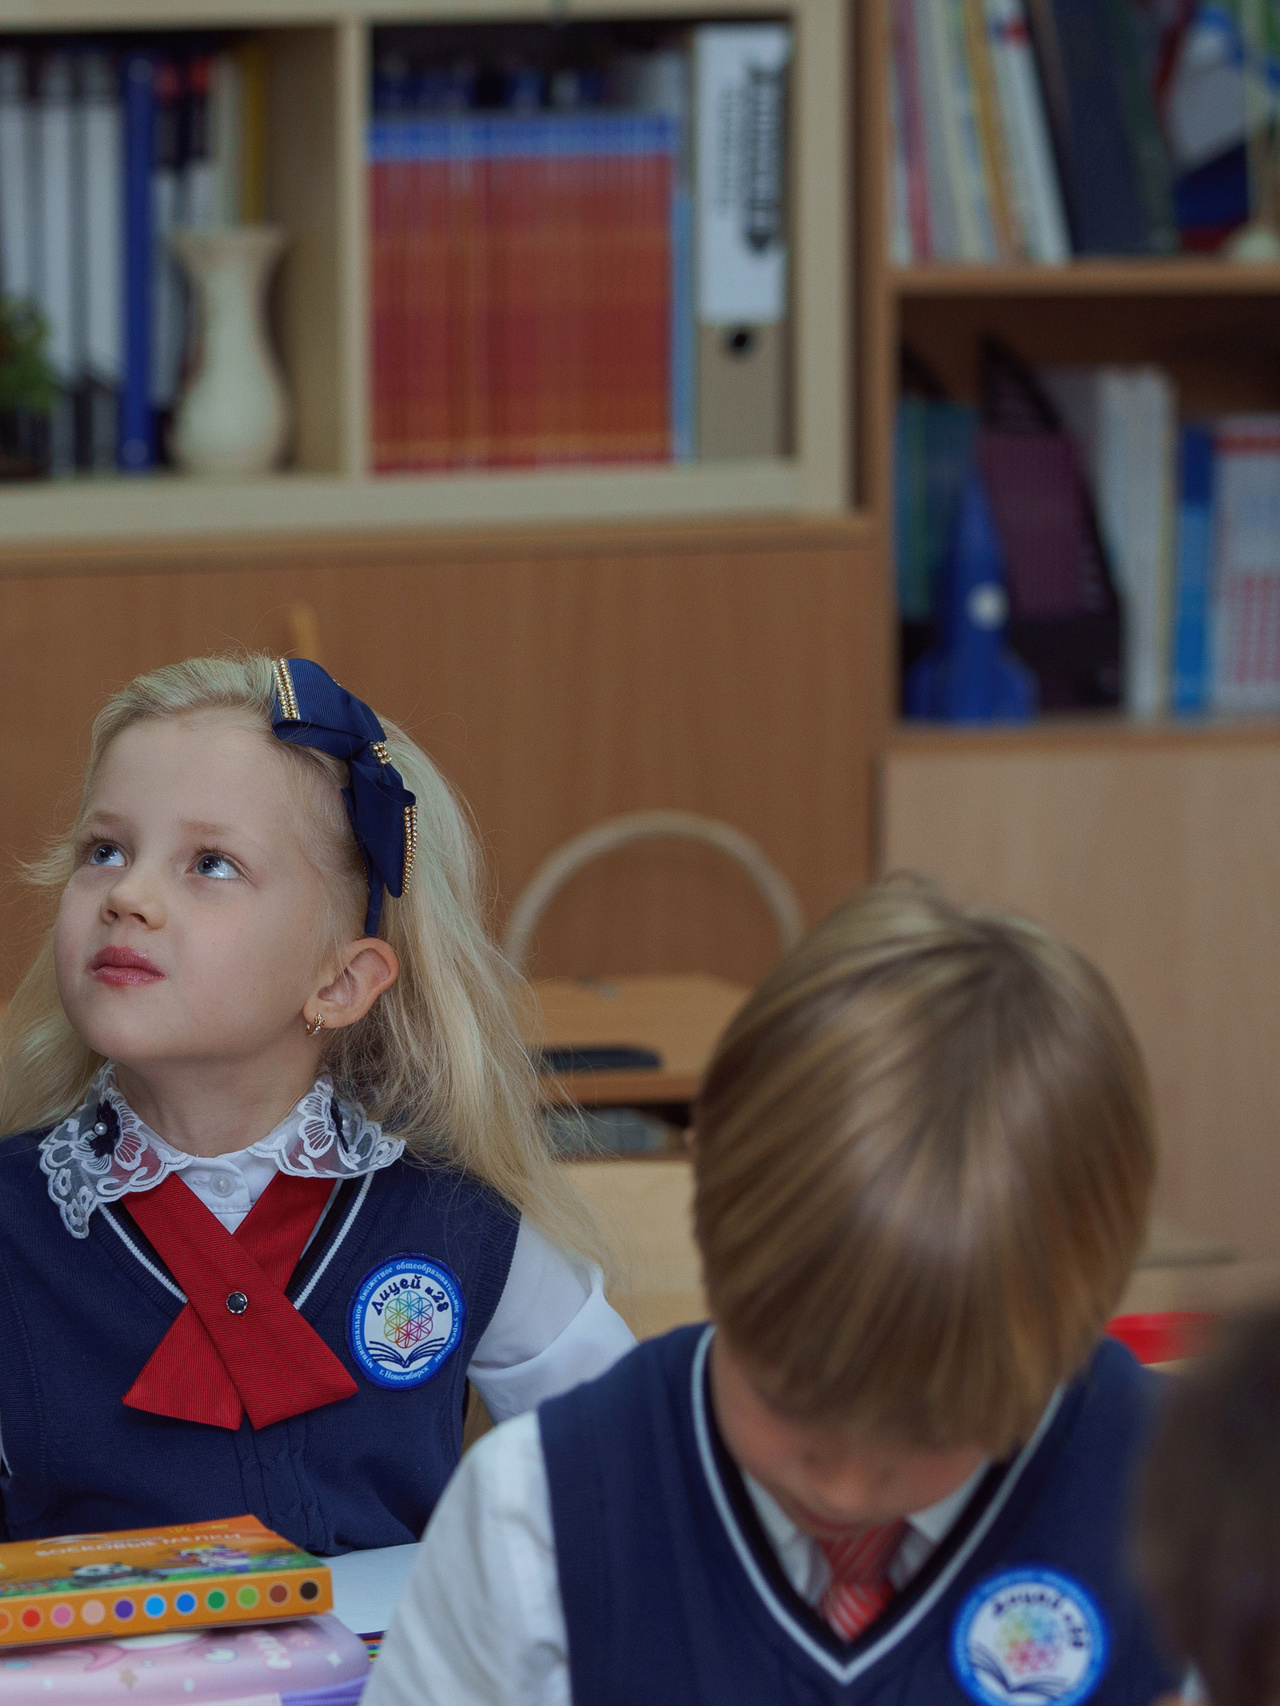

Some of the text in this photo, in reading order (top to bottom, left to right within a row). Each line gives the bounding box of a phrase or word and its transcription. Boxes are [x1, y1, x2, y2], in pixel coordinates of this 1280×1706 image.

[355, 1262, 459, 1368] муниципальное бюджетное общеобразовательное учреждение
[371, 1275, 422, 1315] Лицей
[385, 1366, 430, 1381] Новосибирск
